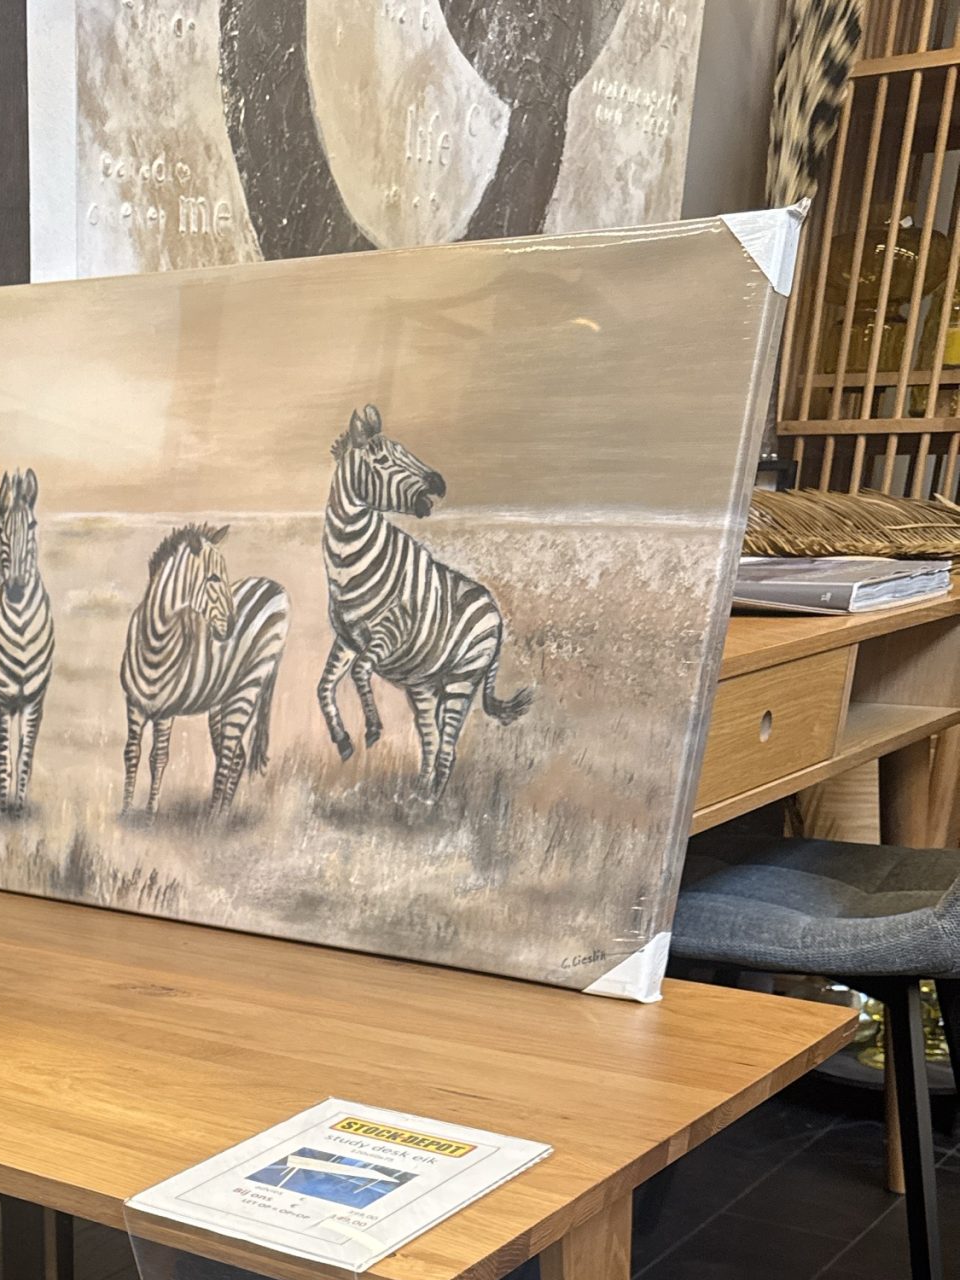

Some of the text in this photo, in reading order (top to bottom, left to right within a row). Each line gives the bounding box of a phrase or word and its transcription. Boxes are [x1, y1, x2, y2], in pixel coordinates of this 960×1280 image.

[324, 1133, 438, 1165] study desk eik
[250, 1193, 273, 1202] ons
